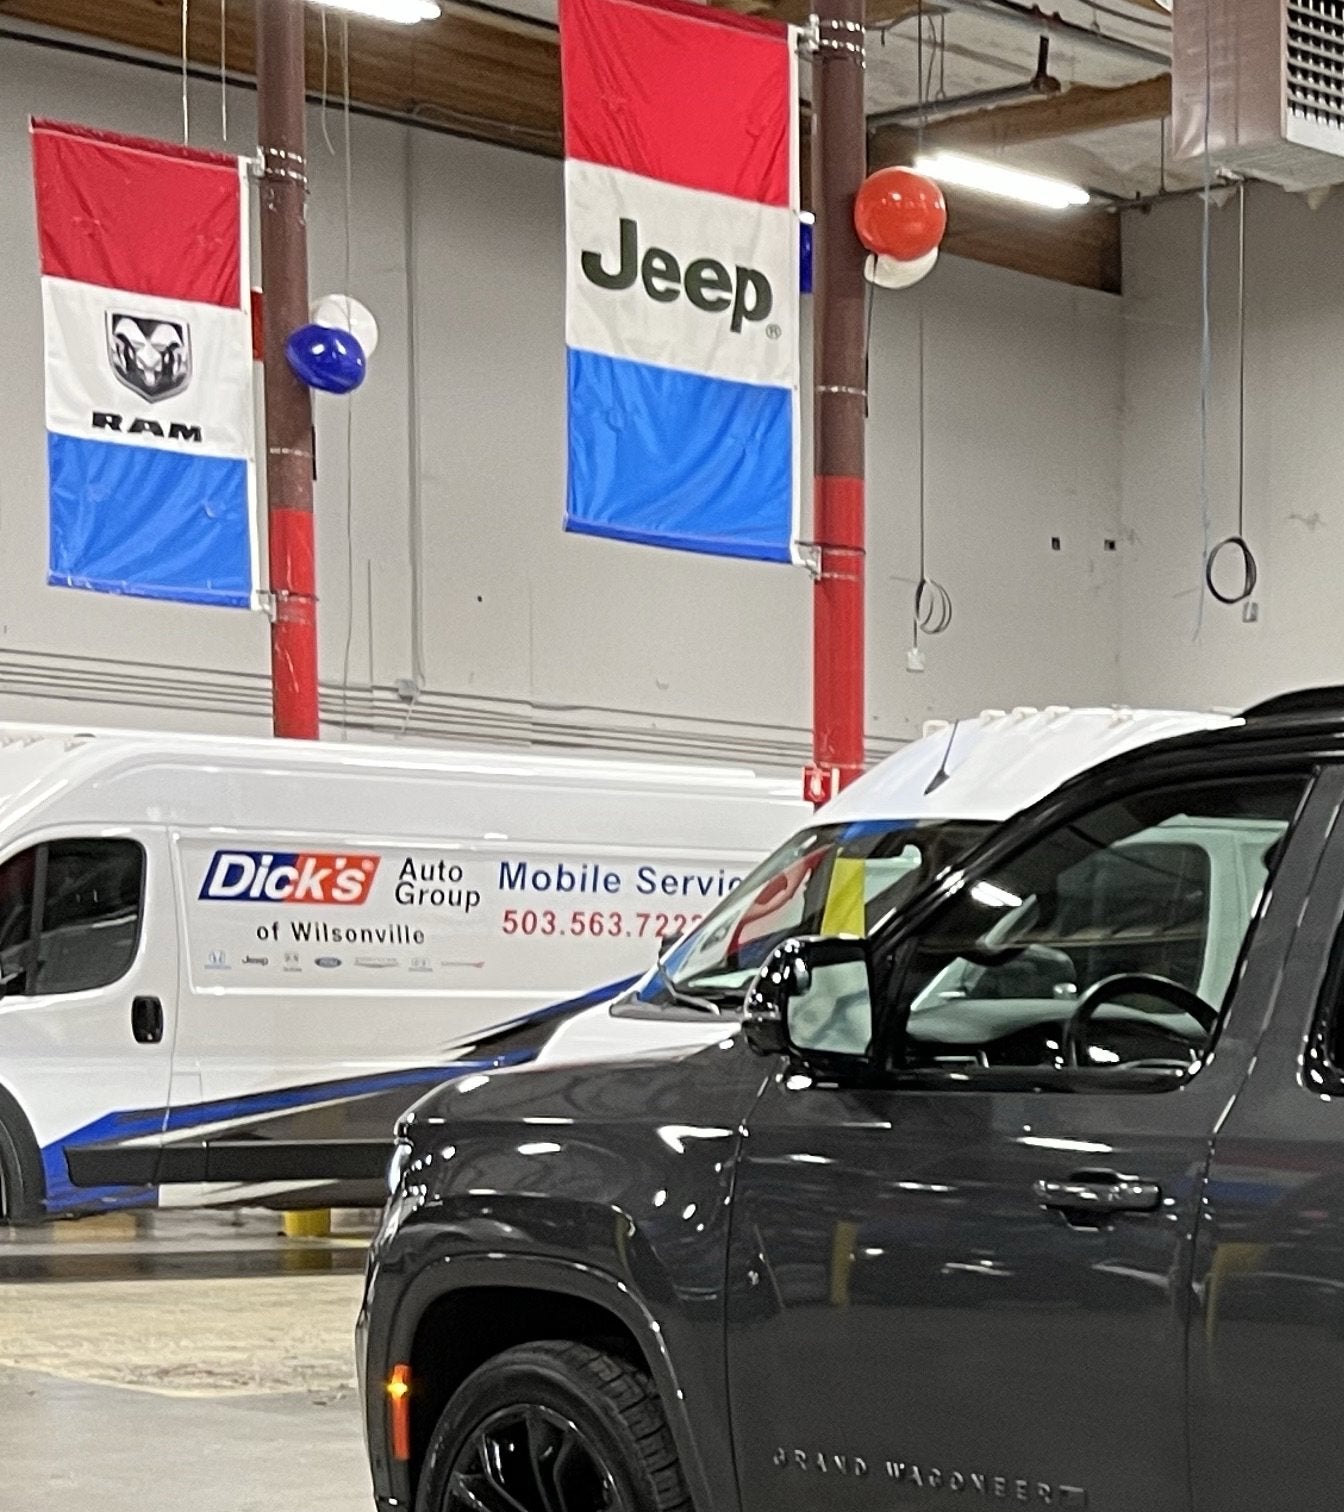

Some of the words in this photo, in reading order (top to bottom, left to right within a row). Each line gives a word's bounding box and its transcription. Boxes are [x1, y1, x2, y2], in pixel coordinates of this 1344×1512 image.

[581, 217, 773, 334] Jeep
[92, 411, 202, 443] RAM
[208, 853, 366, 900] Dick's
[399, 857, 464, 883] Auto
[498, 861, 622, 894] Mobile
[395, 881, 482, 914] Group
[256, 921, 279, 942] of
[291, 921, 425, 945] Wilsonville
[773, 1447, 867, 1476] GRAND
[885, 1461, 1051, 1504] WAGONEER
